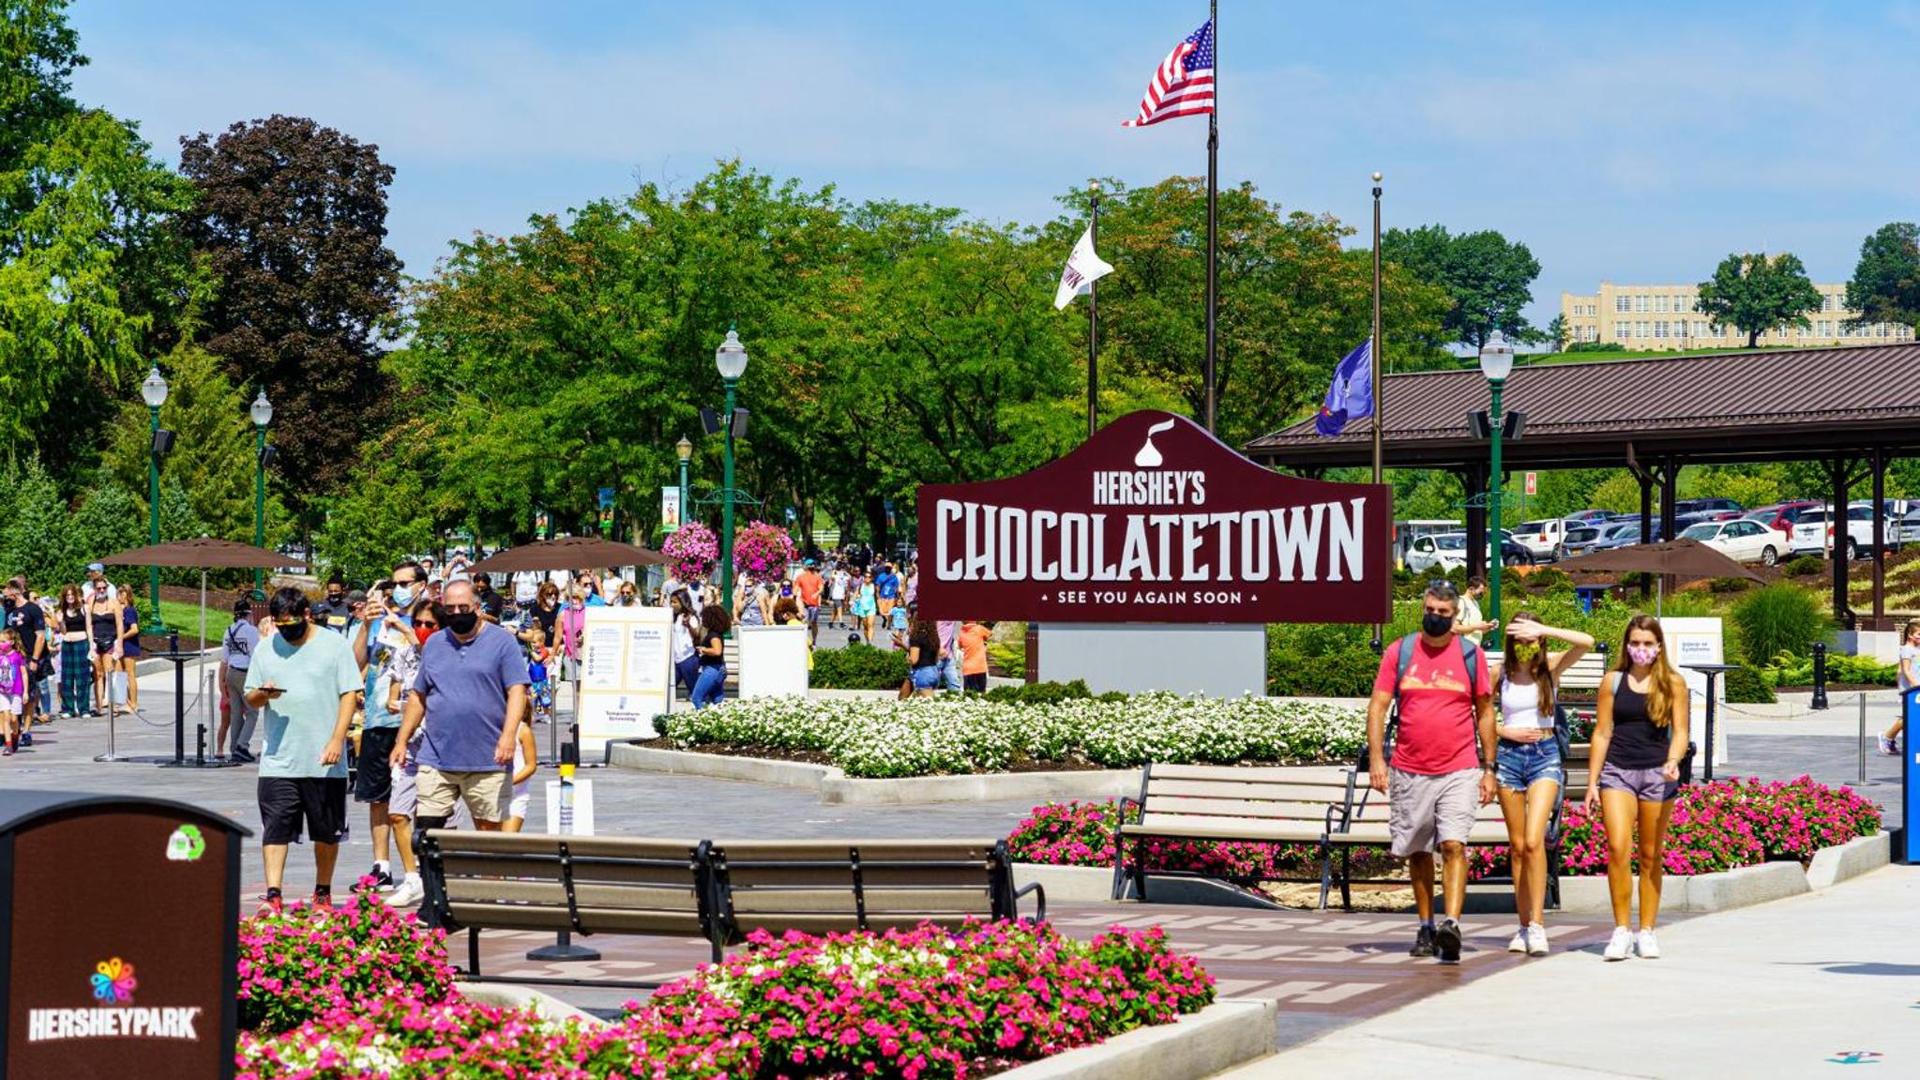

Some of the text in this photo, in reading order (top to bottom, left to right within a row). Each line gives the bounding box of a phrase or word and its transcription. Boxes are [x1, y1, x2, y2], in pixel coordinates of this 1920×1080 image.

[1093, 470, 1206, 506] HERSHEY'S
[936, 497, 1367, 582] CHOCOLATETOWN
[1058, 591, 1242, 604] SEE YOU AGAIN SOON
[29, 1006, 200, 1041] HERSHEYPARK
